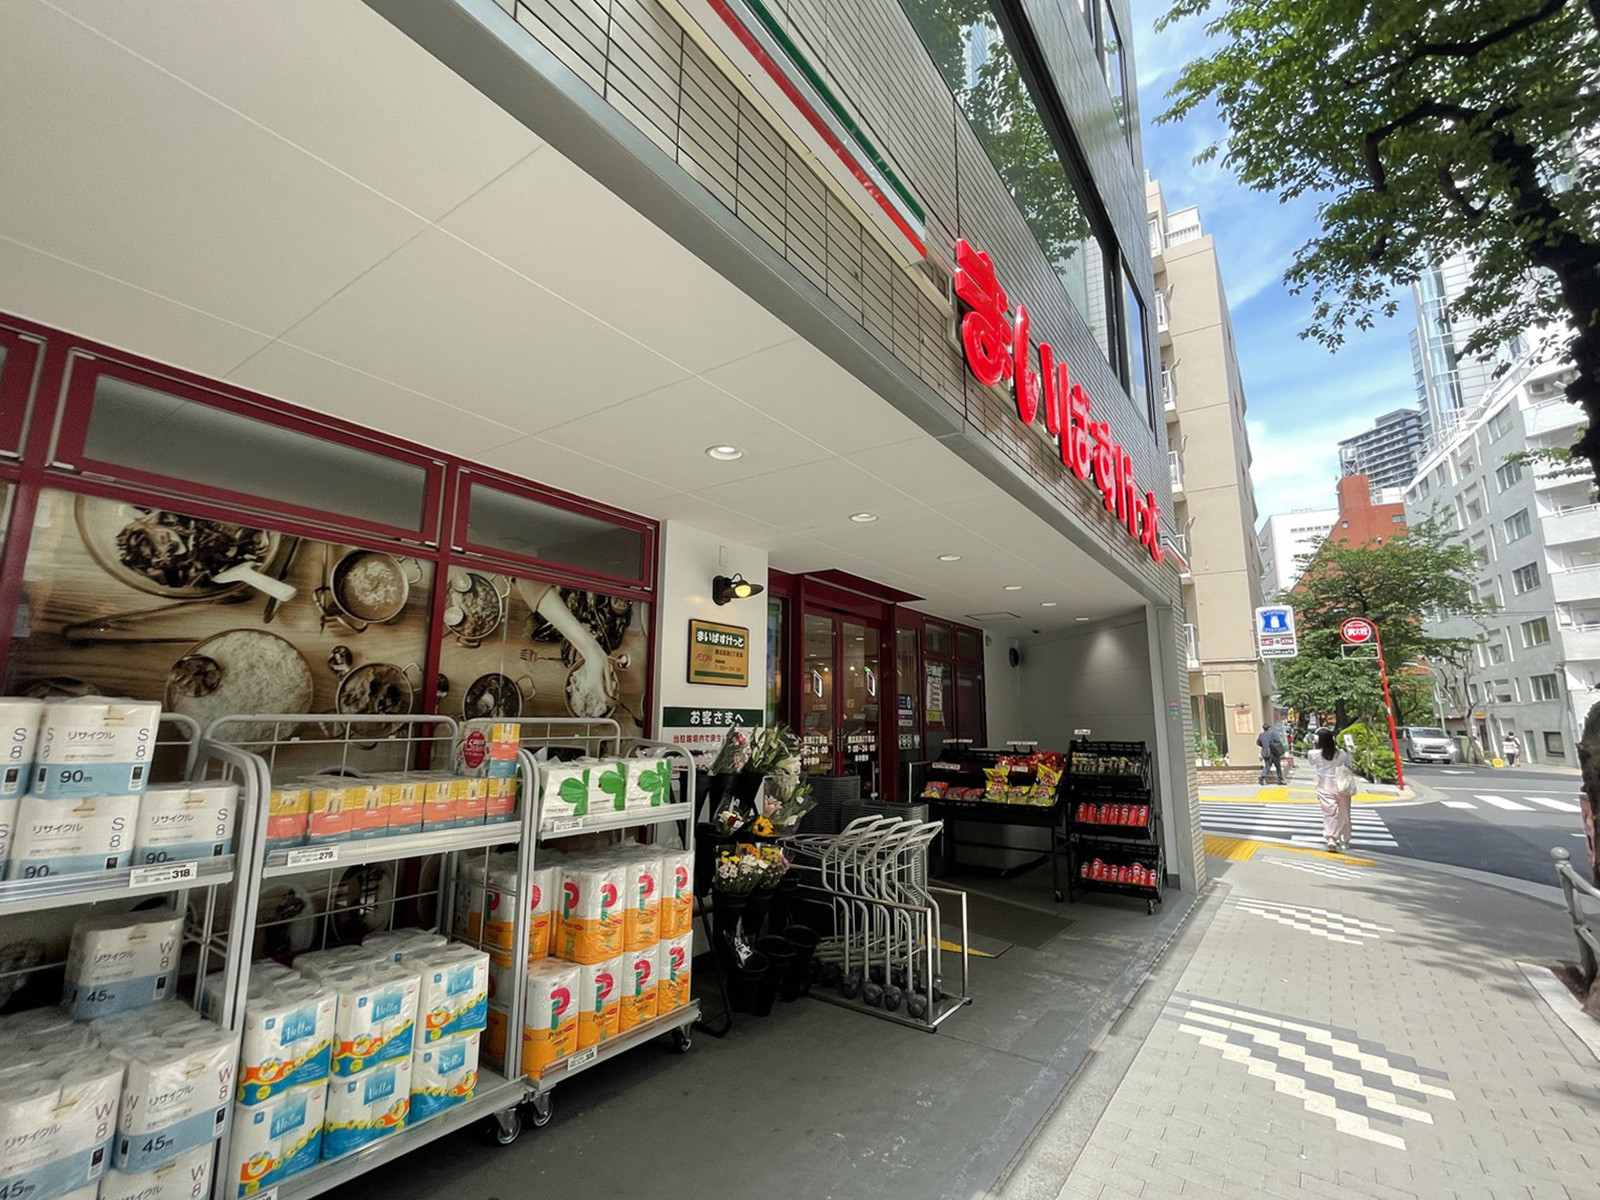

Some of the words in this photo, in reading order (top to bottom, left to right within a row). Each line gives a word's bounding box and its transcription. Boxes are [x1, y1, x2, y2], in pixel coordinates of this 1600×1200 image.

[954, 238, 1165, 564] まいばすけっと
[697, 631, 744, 648] まいばすけっと
[690, 710, 744, 725] お客さまへ
[13, 727, 27, 742] S
[68, 731, 115, 740] リサイクル
[138, 728, 149, 741] S
[10, 745, 23, 759] 8
[136, 744, 146, 758] 8
[60, 770, 93, 783] 90m
[152, 814, 194, 825] リサイクル
[217, 808, 228, 821] S
[33, 823, 83, 835] リサイクル
[112, 817, 125, 831] S
[216, 824, 225, 836] 8
[109, 834, 121, 848] 8
[172, 868, 191, 879] 318
[160, 939, 176, 954] W
[94, 951, 136, 964] リサイクル
[160, 956, 169, 968] 8
[219, 1065, 233, 1082] W
[149, 1085, 194, 1106] リサイクル
[219, 1085, 228, 1099] 8
[95, 1100, 114, 1120] W
[95, 1122, 108, 1139] 8
[192, 1162, 206, 1180] W
